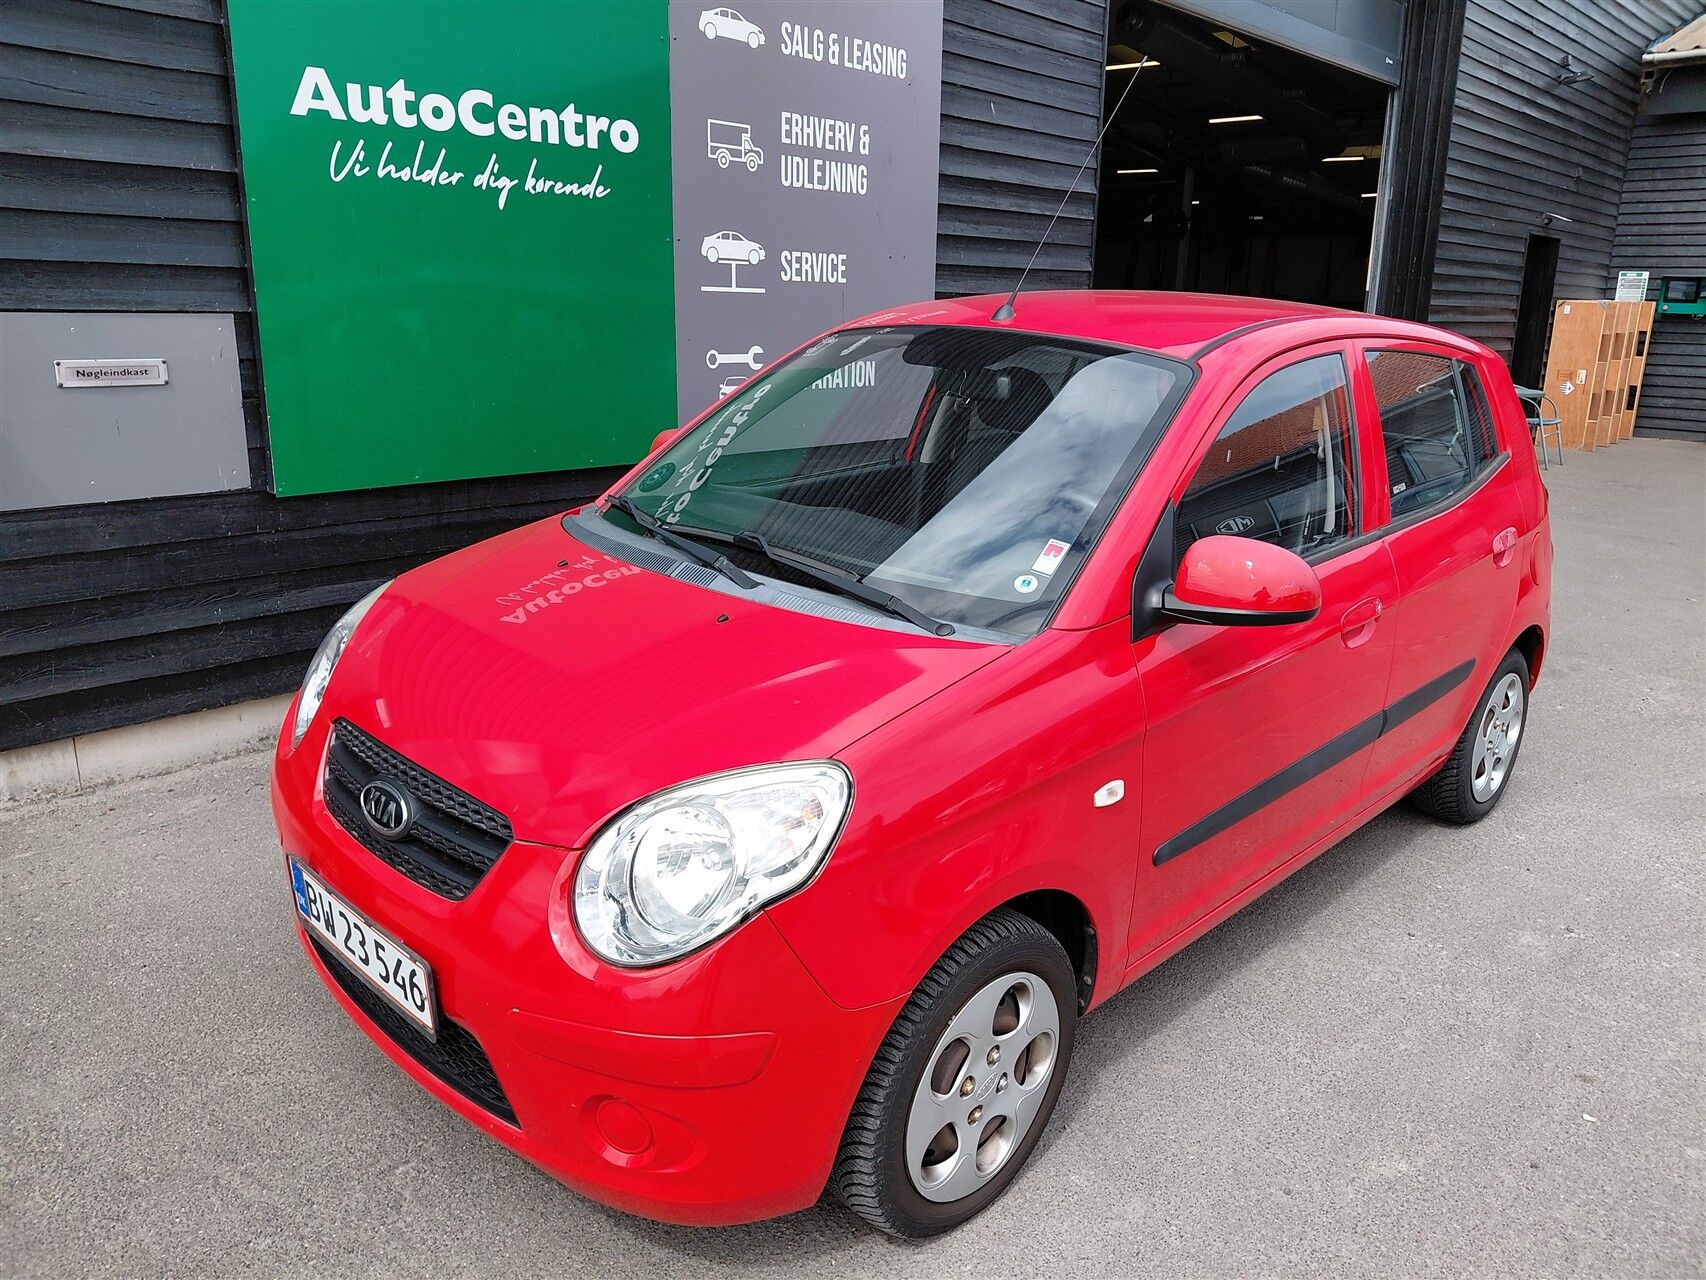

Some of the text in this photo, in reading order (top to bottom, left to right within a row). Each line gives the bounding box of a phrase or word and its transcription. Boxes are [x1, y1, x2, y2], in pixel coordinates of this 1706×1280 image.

[780, 21, 907, 80] SALG & LEASING
[289, 65, 640, 154] AutoCentro
[780, 111, 870, 155] ERHVERV &
[329, 139, 611, 210] Vi holder dig kørende
[780, 154, 868, 195] UDLEJNING
[780, 250, 847, 284] SERVICE
[76, 368, 149, 379] Nøgleindkast
[366, 787, 397, 828] KIA
[305, 880, 426, 1014] BW 23 546
